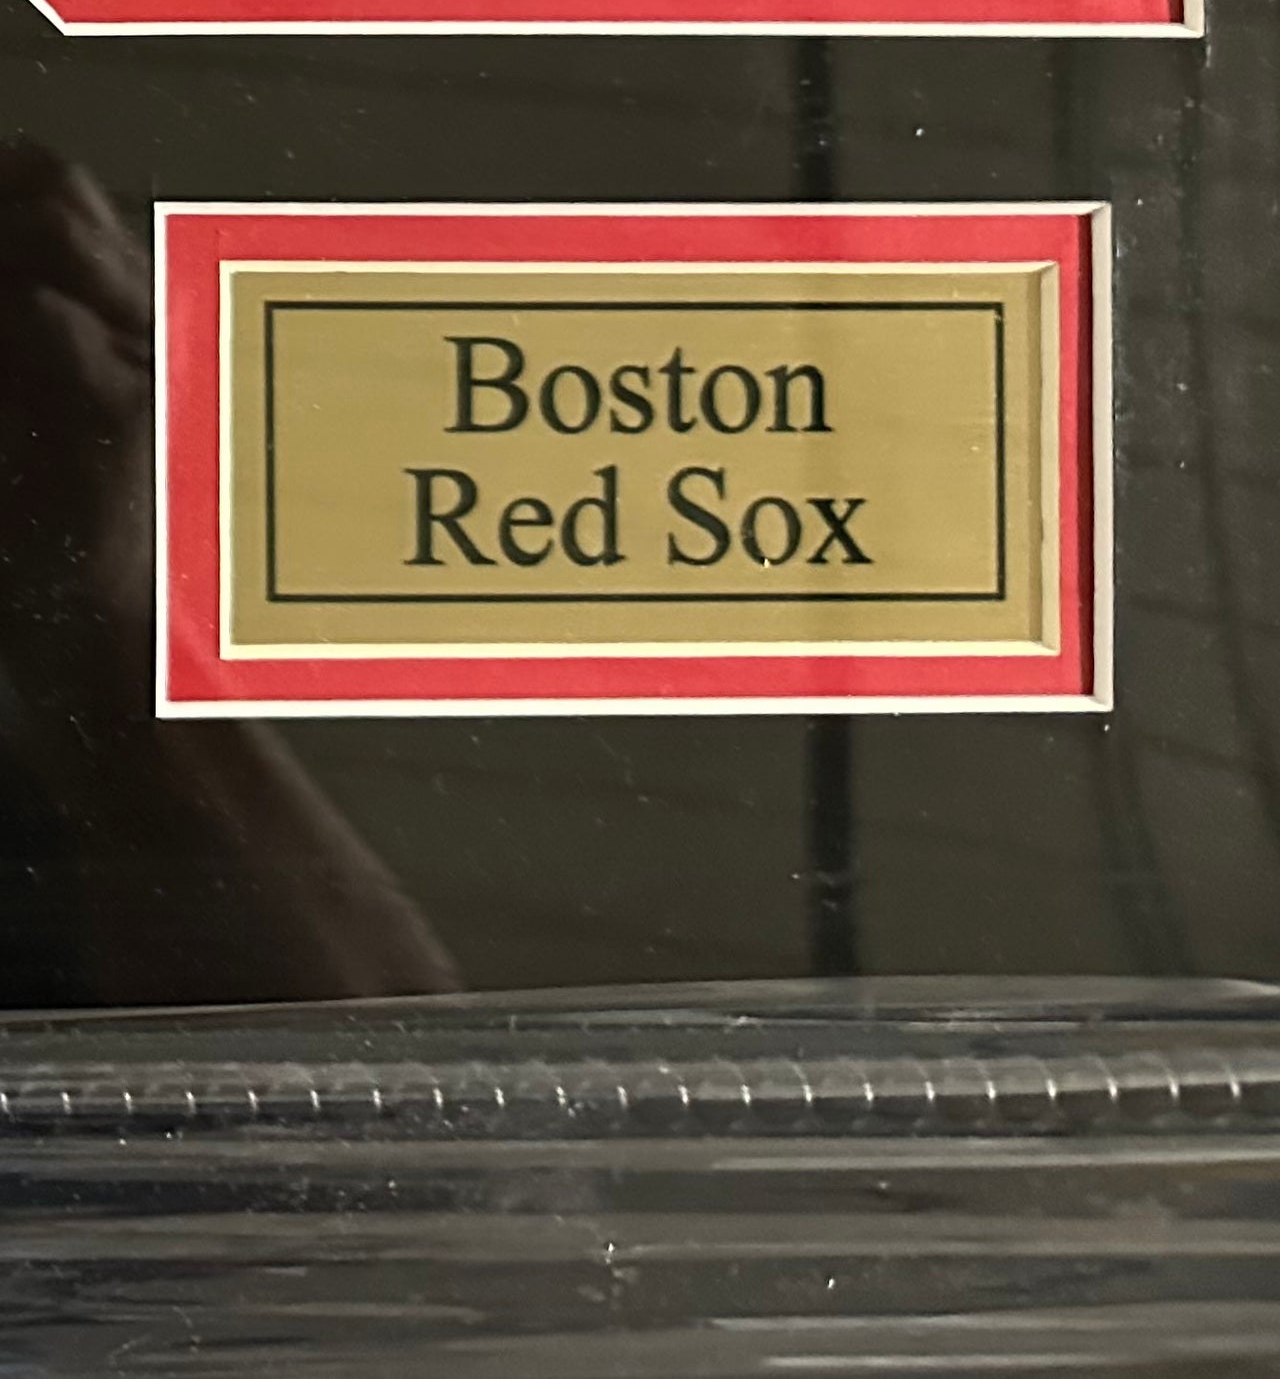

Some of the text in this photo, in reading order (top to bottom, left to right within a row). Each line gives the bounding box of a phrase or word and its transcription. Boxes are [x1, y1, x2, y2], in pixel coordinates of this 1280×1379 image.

[442, 334, 836, 435] Boston
[401, 463, 875, 568] Red Sox
